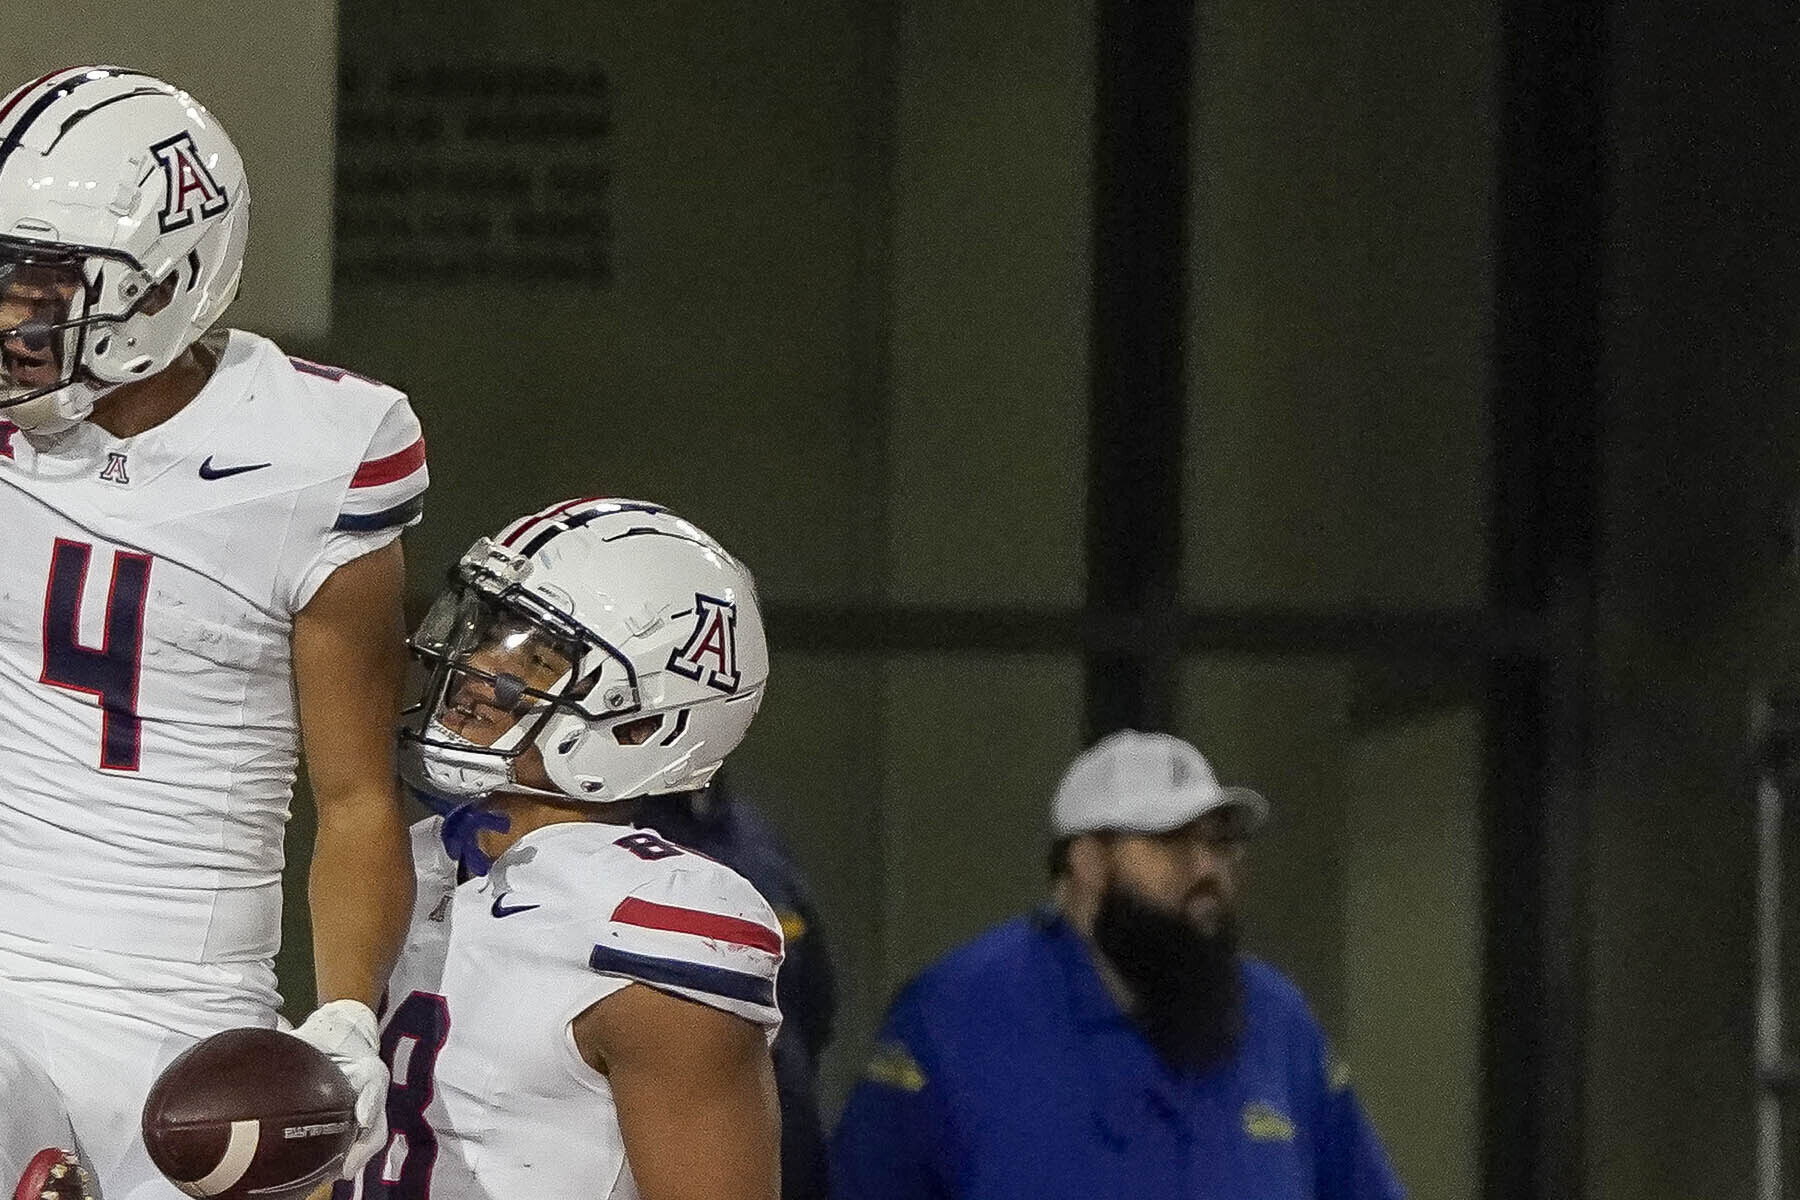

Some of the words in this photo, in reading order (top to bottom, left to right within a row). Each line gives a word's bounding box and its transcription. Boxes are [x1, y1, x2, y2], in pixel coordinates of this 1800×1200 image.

[150, 130, 228, 233] A
[99, 452, 129, 484] A
[40, 537, 153, 772] 4
[666, 592, 741, 693] A
